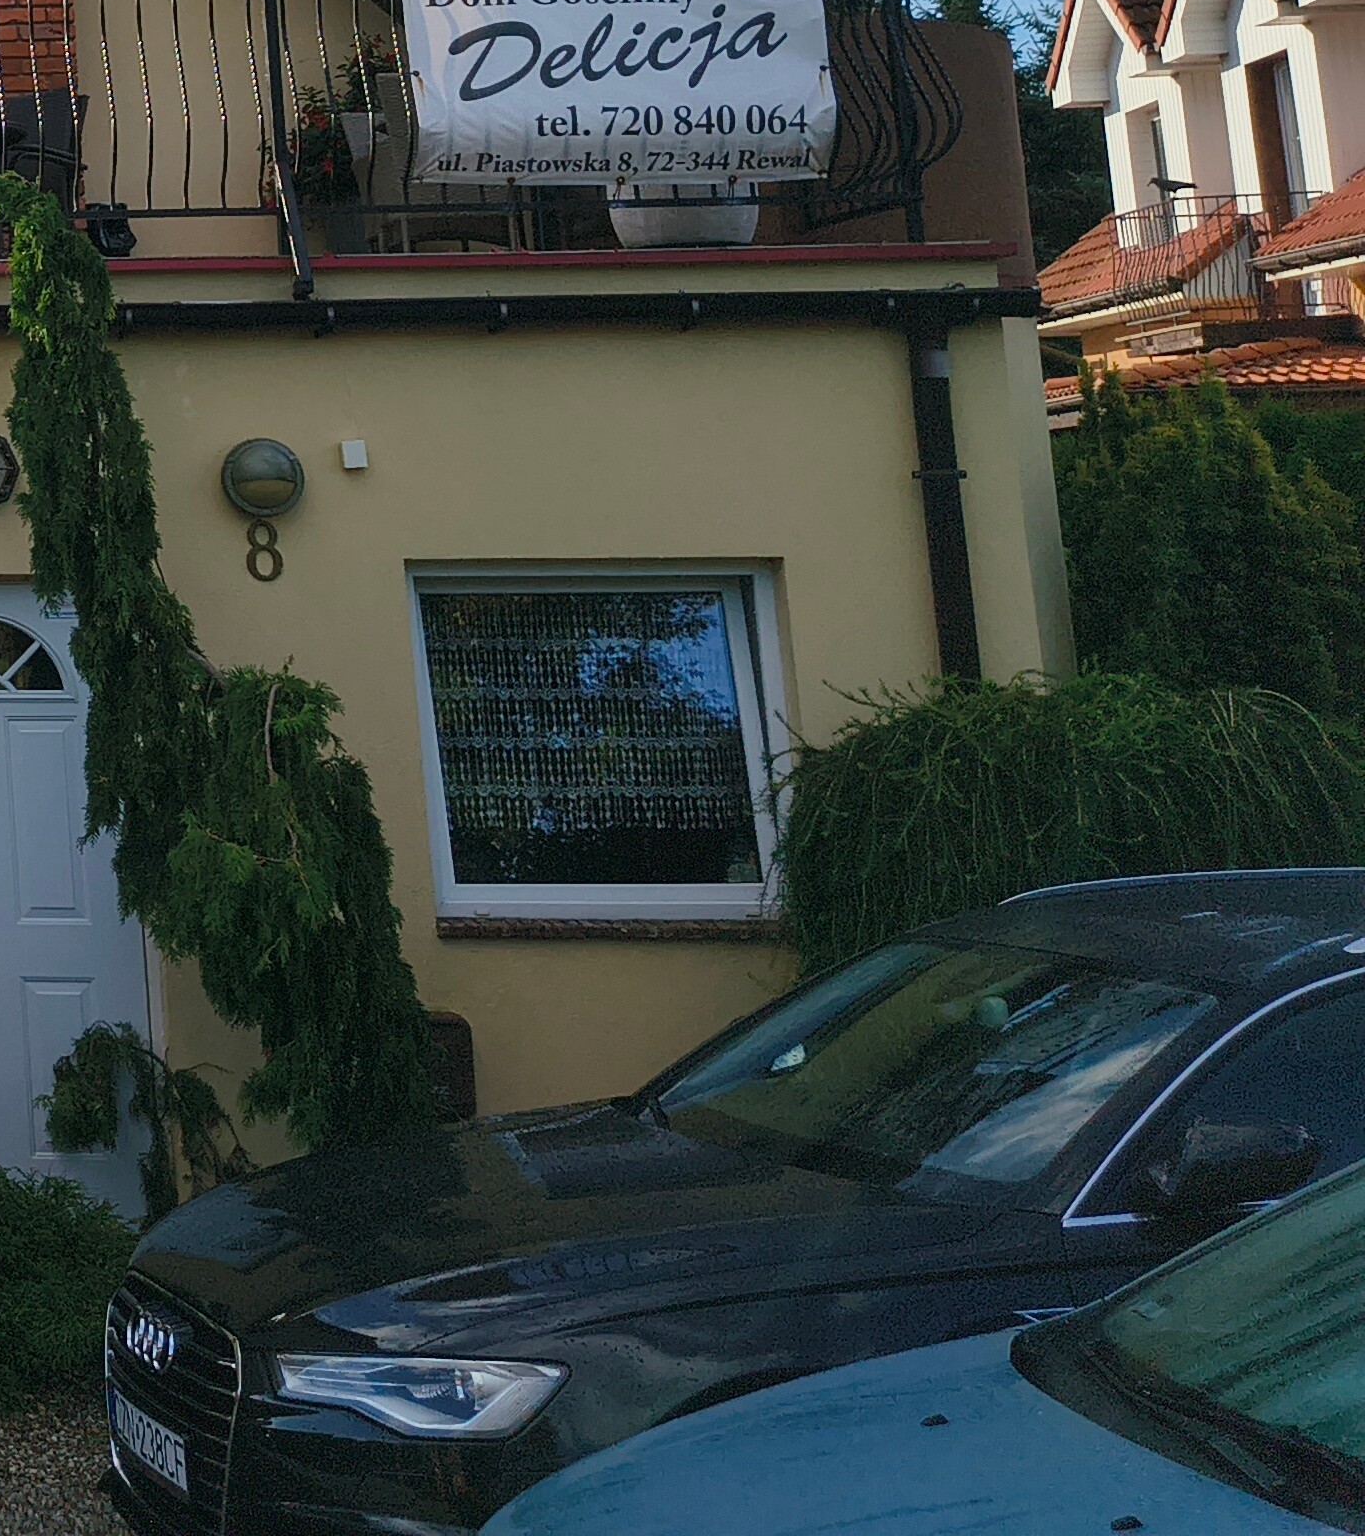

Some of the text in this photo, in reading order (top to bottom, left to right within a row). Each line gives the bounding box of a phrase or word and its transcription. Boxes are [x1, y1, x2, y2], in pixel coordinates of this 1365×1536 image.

[448, 3, 788, 102] Delicja
[535, 104, 808, 137] tel. 720 840 064
[437, 146, 812, 176] ul. Piastowska 8, 72-344 Rewal
[246, 518, 284, 583] 8
